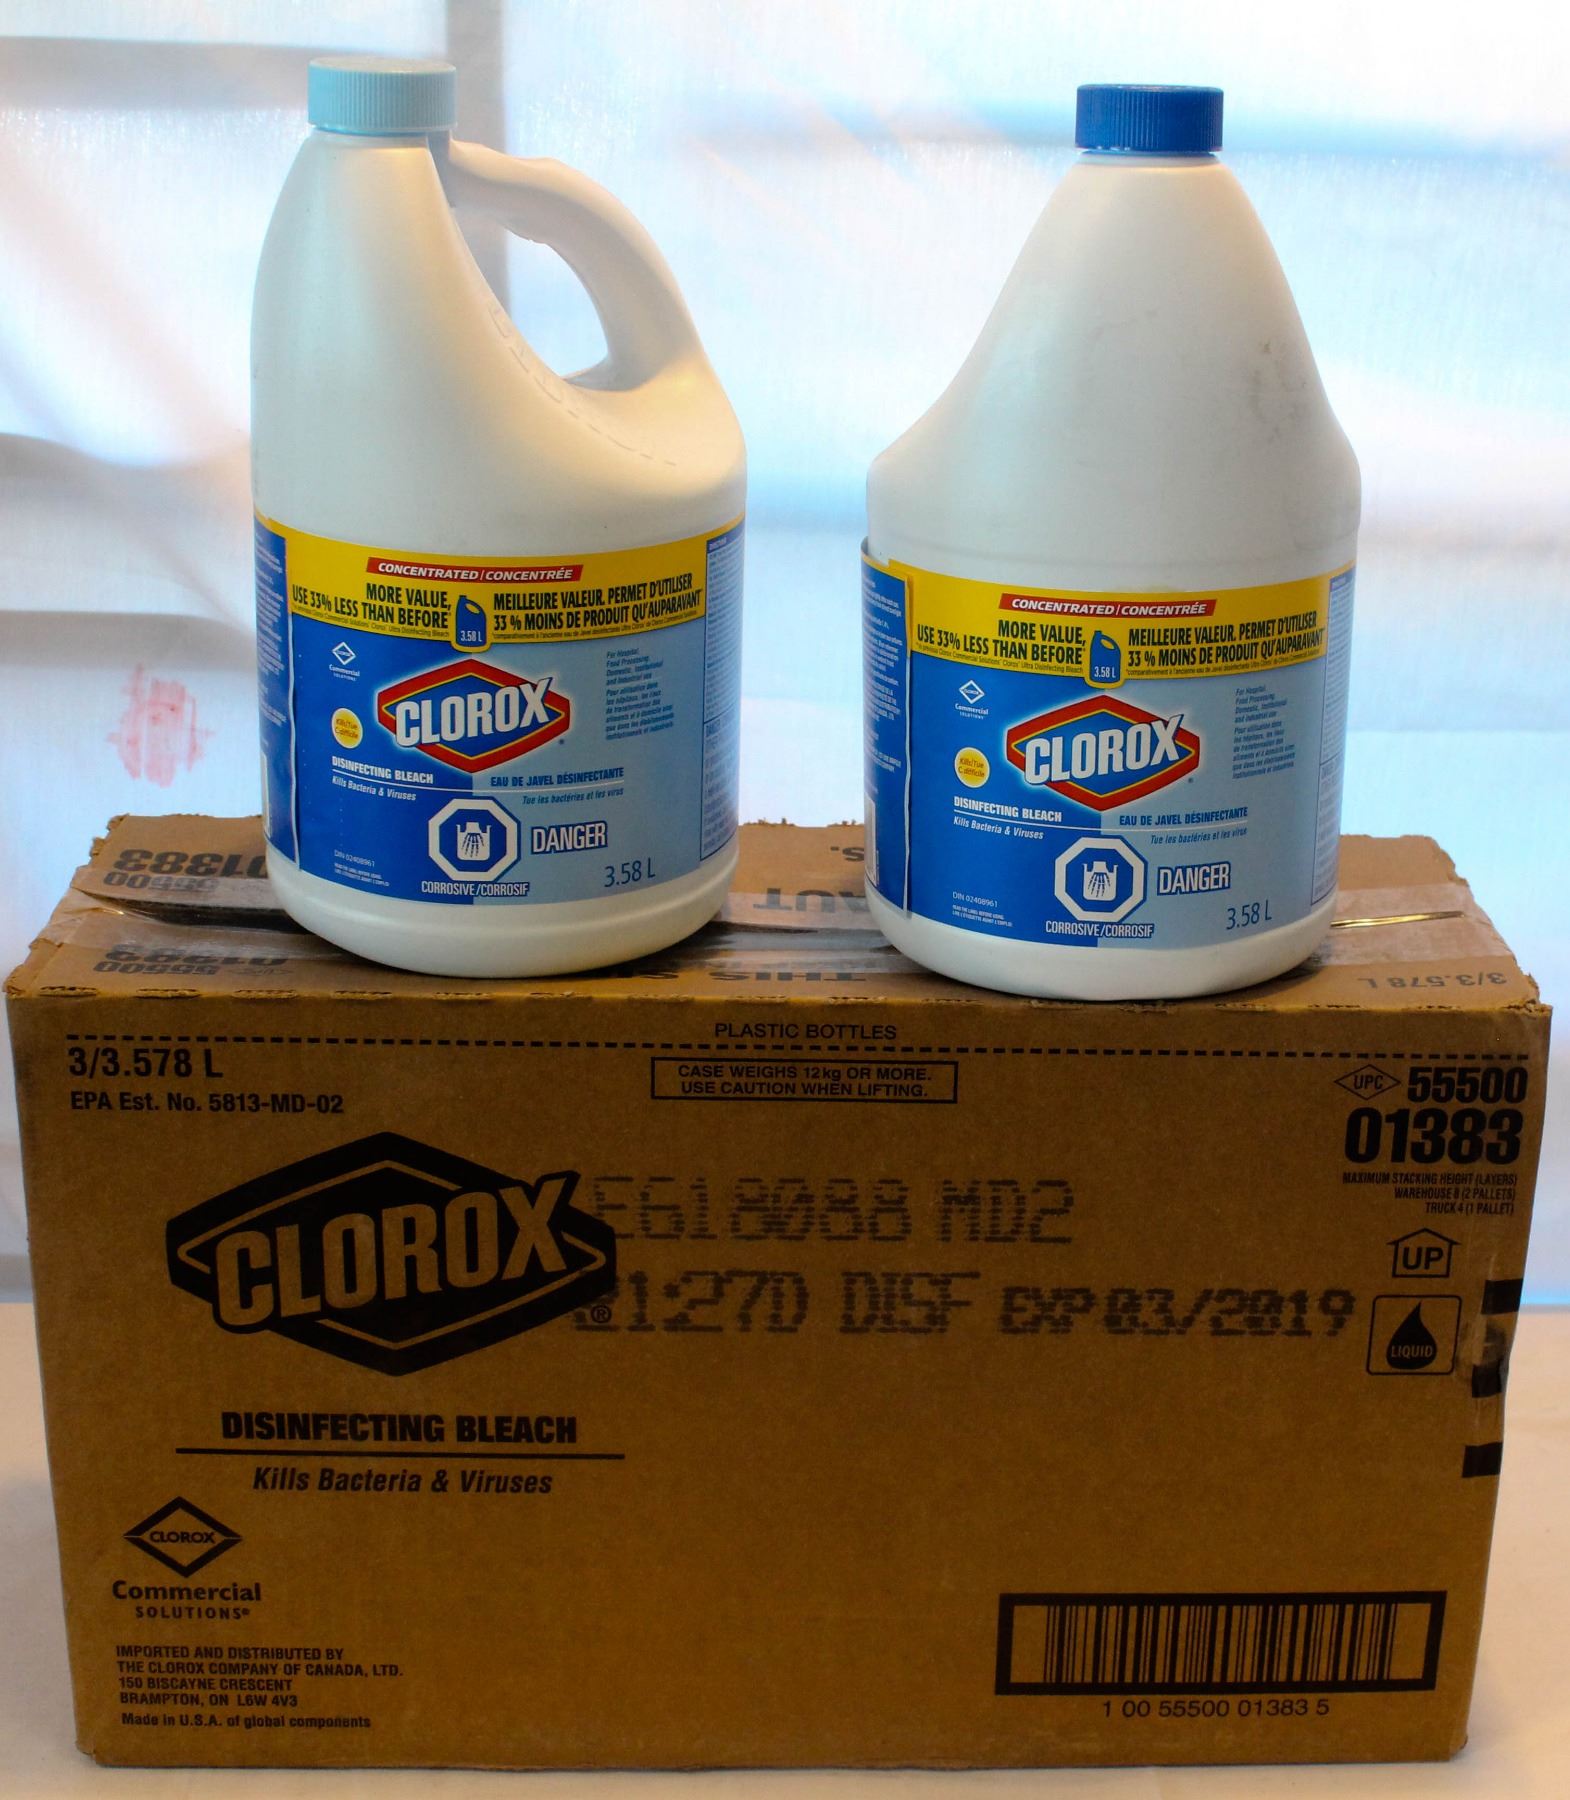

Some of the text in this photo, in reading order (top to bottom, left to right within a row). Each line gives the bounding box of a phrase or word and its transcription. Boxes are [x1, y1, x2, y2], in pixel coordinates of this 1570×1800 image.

[366, 582, 451, 611] MORE VALUE,
[493, 592, 558, 611] MEILLEURE
[608, 583, 648, 604] PERMET
[649, 572, 693, 598] D'UTILISER
[493, 614, 507, 631] 33
[510, 614, 522, 631] %
[524, 613, 564, 631] MOINS
[566, 611, 581, 628] DE
[583, 606, 629, 627] PRODUIT
[1128, 627, 1192, 647] MEILLEURE
[1239, 619, 1276, 641] PERMET
[1277, 610, 1317, 634] D'UTILISER
[917, 624, 934, 644] USE
[937, 629, 960, 650] 33%
[963, 634, 988, 656] LESS
[992, 639, 1028, 662] THAN
[998, 619, 1086, 646] MORE VALUE,
[1128, 650, 1141, 667] 33
[1144, 650, 1155, 666] %
[1158, 648, 1196, 666] MOINS
[1199, 647, 1213, 664] DE
[1215, 642, 1260, 663] PRODUIT
[1094, 666, 1110, 678] 3.58
[1111, 667, 1116, 678] L
[396, 677, 551, 747] CLOROX
[1025, 714, 1182, 784] CLOROX
[332, 755, 433, 784] DISINFECTING BLEACH
[332, 775, 417, 801] Kills Bacteria & Viruses
[953, 795, 1062, 822] DISINFECTING BLEACH
[1119, 806, 1248, 826] EAU DE JAVEL DÉSINFECTANTE
[533, 822, 606, 853] DANGER
[953, 815, 1044, 840] Kills Bacteria & Viruses
[1150, 834, 1163, 844] Tue
[1165, 833, 1176, 843] les
[1178, 831, 1212, 843] bactéries
[604, 857, 656, 888] 3.58 L
[1159, 863, 1230, 893] DANGER
[421, 880, 530, 897] CORROSIVE/CORROSIF
[952, 891, 964, 901] DIN
[1226, 899, 1272, 930] 3.58 L
[1045, 919, 1154, 937] CORROSIVE/CORROSIF
[714, 1023, 897, 1040] PLASTIC BOTTLES
[68, 1046, 223, 1079] 3/3.578 L
[678, 1065, 724, 1079] CASE
[729, 1065, 797, 1079] WEIGHS
[847, 1067, 870, 1080] OR
[877, 1067, 932, 1081] MORE.
[681, 1081, 928, 1097] USE CAUTION WHEN LIFTING.
[1353, 1066, 1528, 1103] UPC 55500
[71, 1091, 344, 1114] EPA Est. No. 5813-MD-02
[1344, 1107, 1523, 1164] 01383
[1342, 1172, 1517, 1187] MAXIMUM STACKING HEIGHT (LAYERS)
[1394, 1187, 1452, 1200] WAREHOUSE
[1472, 1188, 1516, 1201] PALLETS)
[935, 1178, 1075, 1244] MD2
[1425, 1202, 1456, 1214] TRUCK
[1475, 1203, 1514, 1216] PALLET)
[215, 1177, 568, 1326] CLOROX
[1402, 1246, 1443, 1270] UP
[1391, 1345, 1434, 1358] LIQUID
[222, 1411, 577, 1443] DISINFECTING BLEACH
[253, 1467, 553, 1494] Kills Bacteria & Viruses
[150, 1531, 216, 1544] CLOROX
[112, 1580, 262, 1601] Commercial
[116, 1645, 344, 1660] IMPORTED AND DISTRIBUTED BY
[118, 1661, 404, 1678] THE CLOROX COMPANY OF CANADA, LTD.
[119, 1677, 292, 1692] 150 BISCAYNE CRESCENT
[120, 1692, 298, 1708] BRAMPTON, ON L6W 4V3
[1103, 1699, 1330, 1718] 1 00 55500 01383 5
[121, 1713, 371, 1730] Made in U.S.A. of global components
